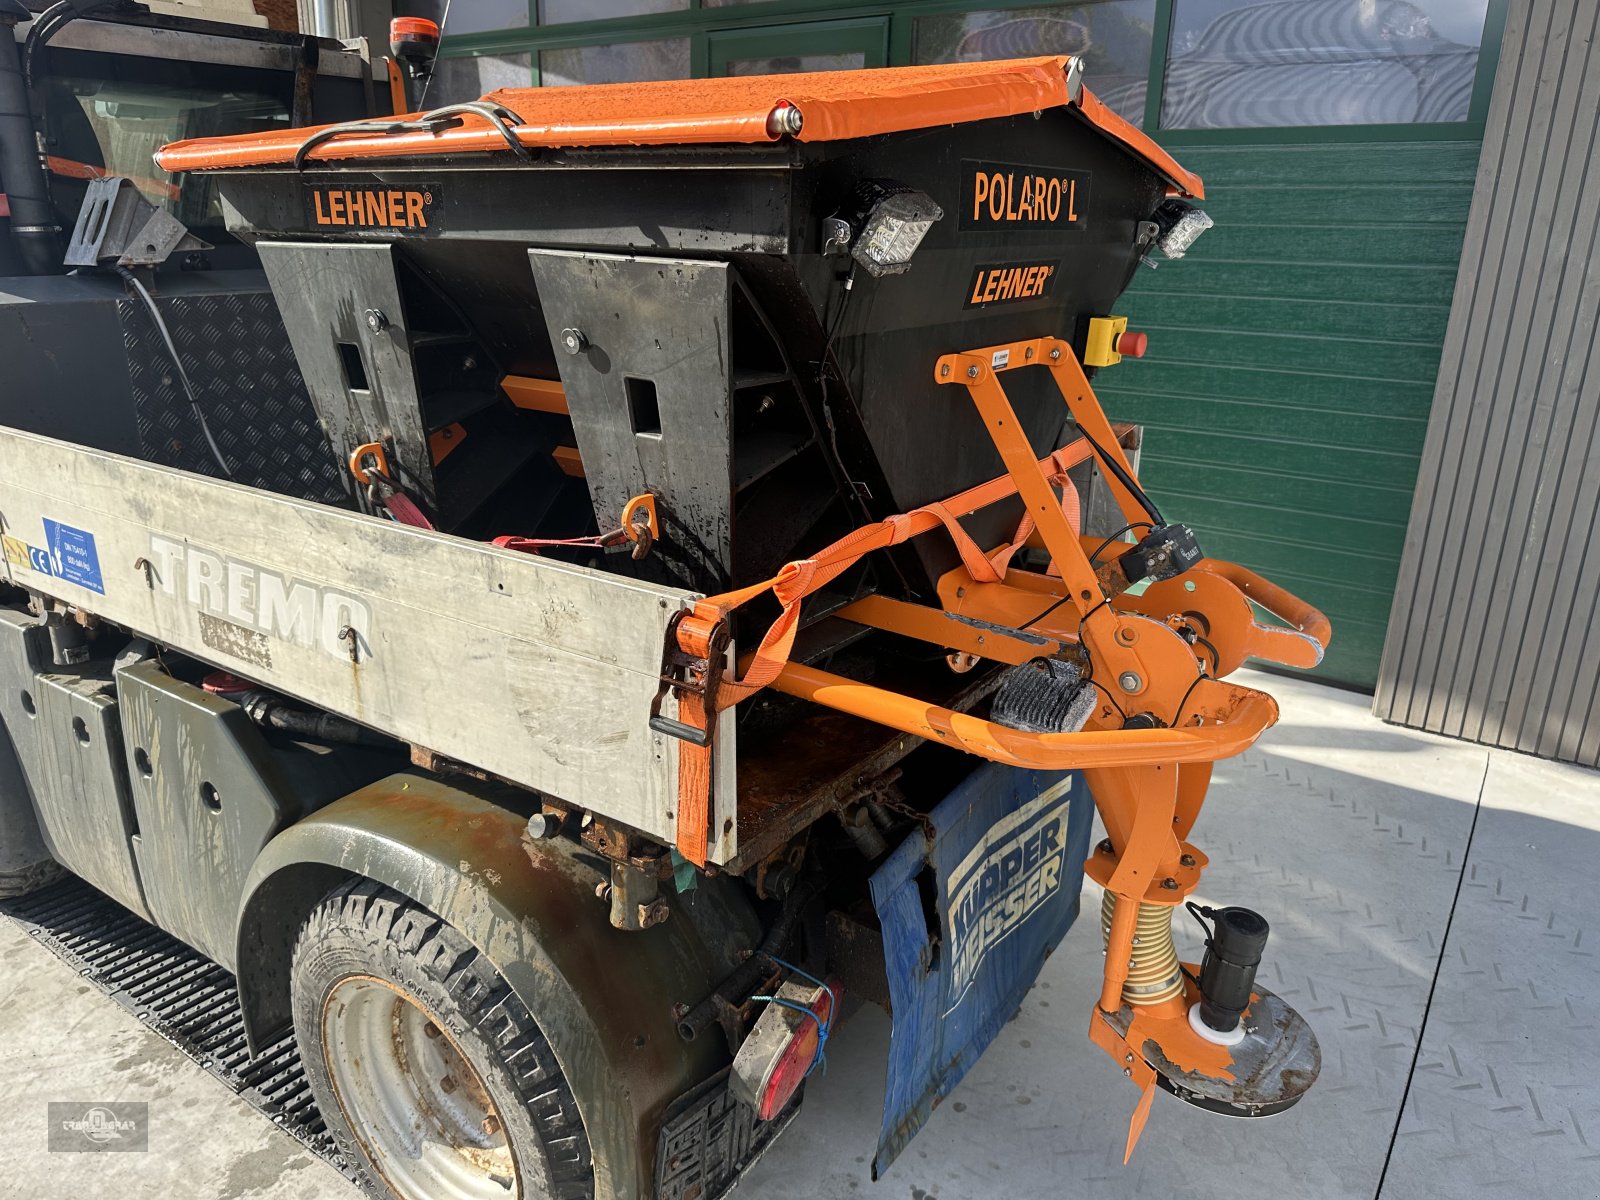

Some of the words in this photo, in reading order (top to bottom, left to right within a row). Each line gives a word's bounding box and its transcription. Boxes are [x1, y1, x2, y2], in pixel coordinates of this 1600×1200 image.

[1068, 179, 1077, 222] L
[30, 548, 47, 573] CE
[151, 535, 370, 664] TREMO
[951, 855, 1062, 1002] WEISSER
